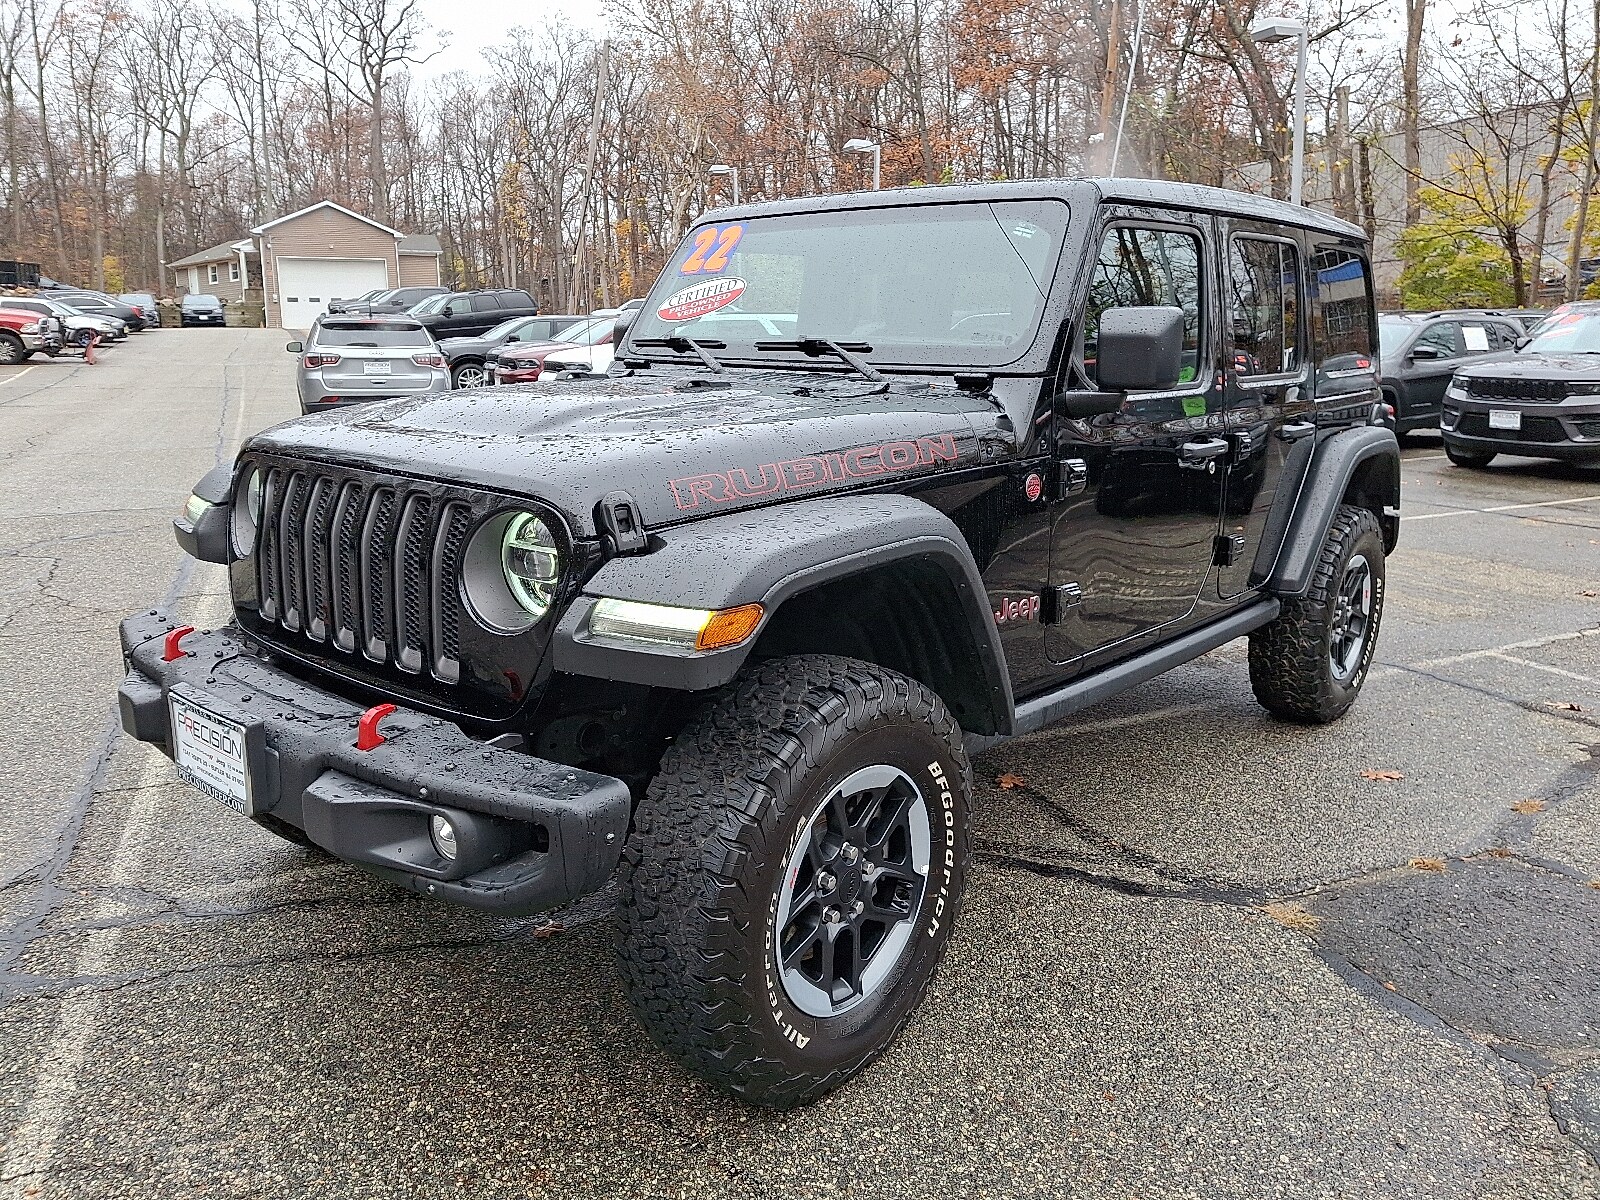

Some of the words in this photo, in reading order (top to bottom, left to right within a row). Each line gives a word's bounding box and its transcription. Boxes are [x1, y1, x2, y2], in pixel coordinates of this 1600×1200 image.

[681, 226, 743, 274] 22
[668, 279, 738, 306] CERTIFIED
[668, 293, 732, 314] PRE-OWNED
[676, 302, 721, 317] VEHICLE
[670, 433, 959, 510] RUBICON
[995, 595, 1041, 624] Jeep
[177, 711, 242, 760] PRECISION
[927, 760, 956, 938] BFGoodrich
[763, 891, 811, 1050] All-Terrain
